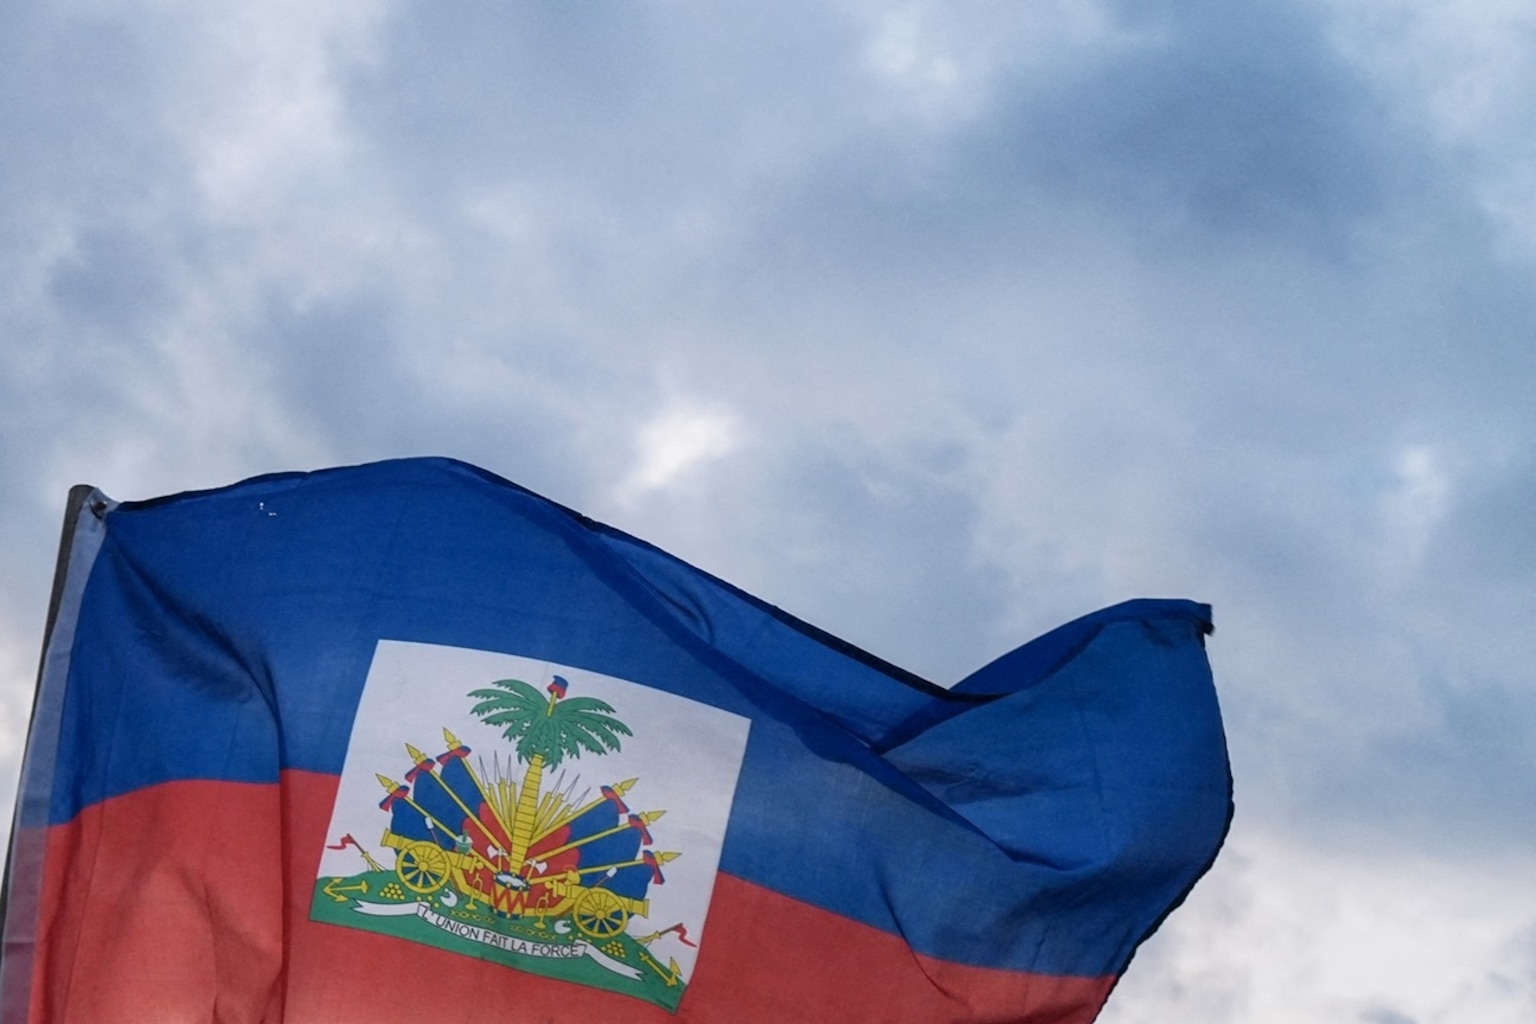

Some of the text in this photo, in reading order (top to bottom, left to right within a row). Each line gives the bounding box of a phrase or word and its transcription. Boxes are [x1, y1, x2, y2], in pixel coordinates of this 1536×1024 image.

[482, 931, 509, 950] FAIT
[511, 939, 527, 954] LA
[531, 943, 579, 957] FORCE
